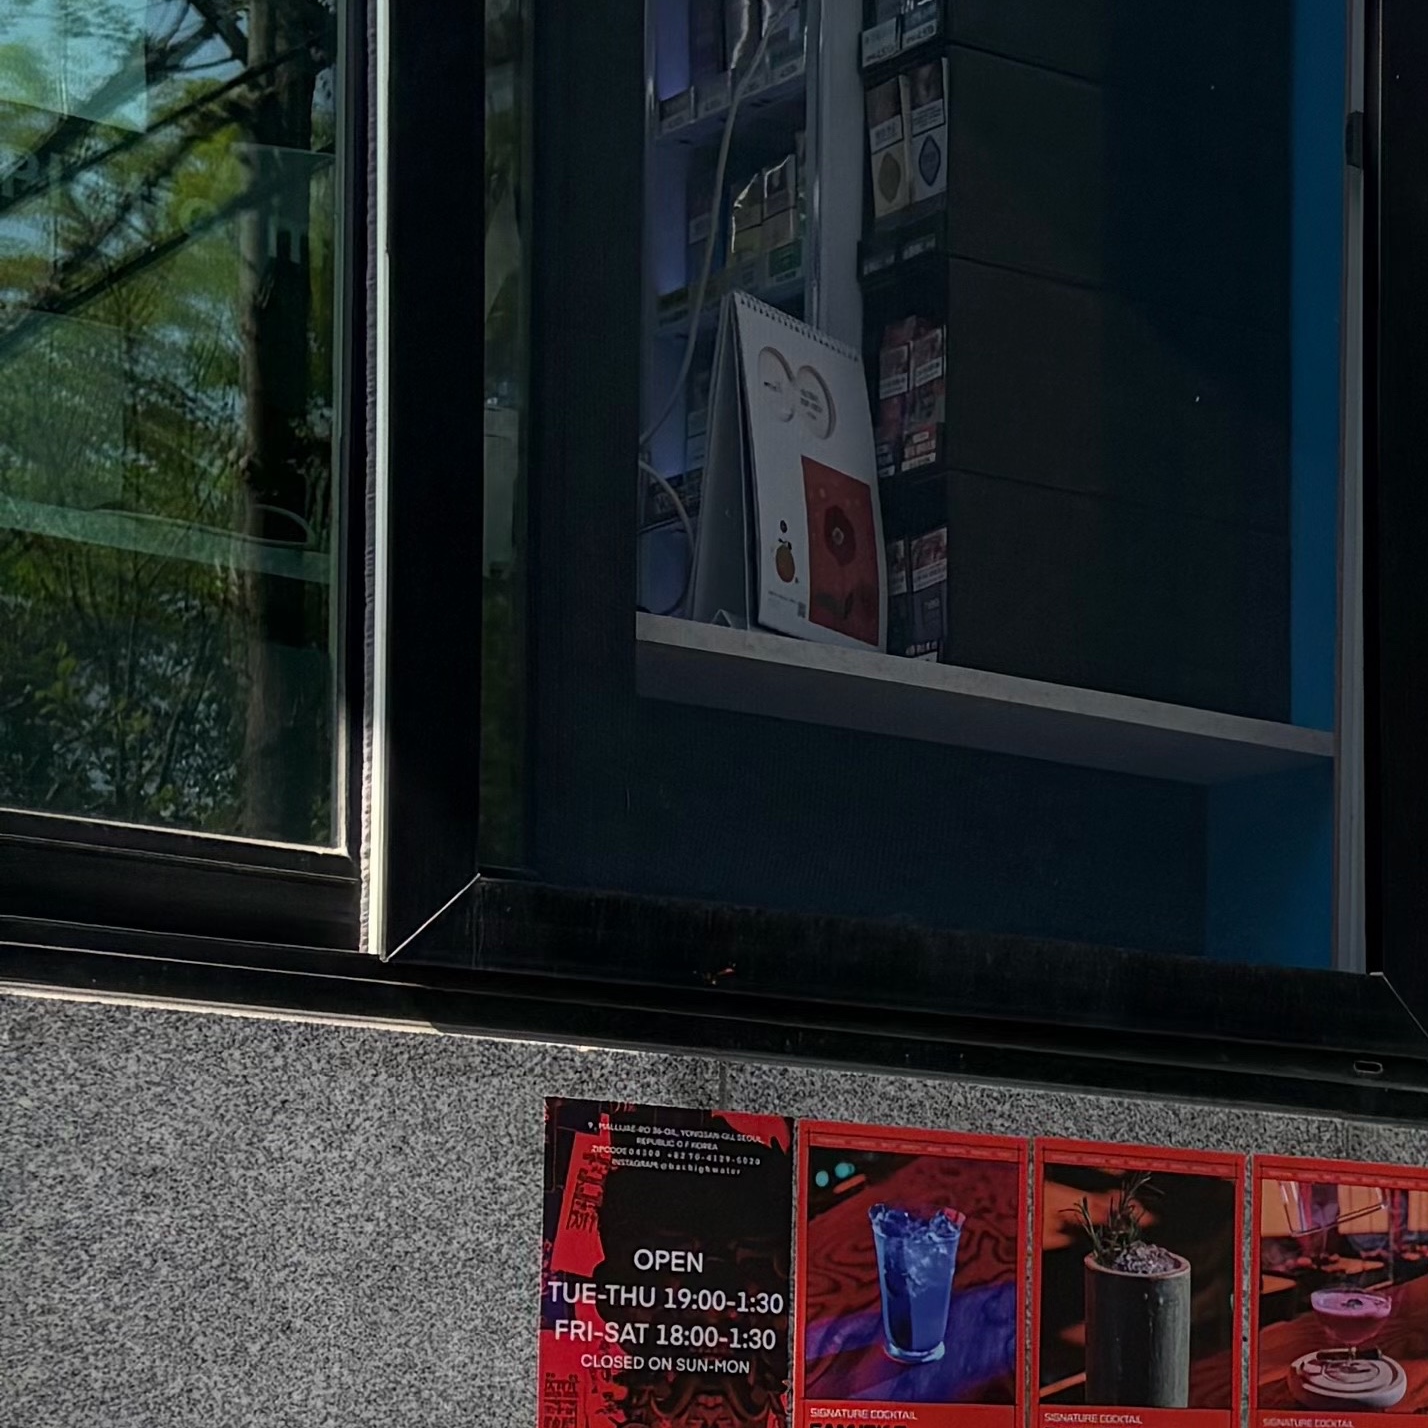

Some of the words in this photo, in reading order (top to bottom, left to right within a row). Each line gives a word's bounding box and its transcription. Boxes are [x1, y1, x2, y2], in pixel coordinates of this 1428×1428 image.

[636, 1137, 675, 1147] REPUBLIC
[691, 1141, 718, 1151] KOREA
[633, 1248, 704, 1273] OPEN
[548, 1280, 657, 1309] TUE-THU
[663, 1287, 784, 1315] 19:00-1:30
[554, 1320, 650, 1345] FRI-SAT
[655, 1324, 776, 1350] 18:00-1:30
[580, 1354, 644, 1371] CLOSED
[648, 1356, 671, 1371] ON
[676, 1357, 750, 1374] SUN-MON
[810, 1408, 870, 1420] SIGNATURE
[870, 1410, 917, 1420] COCKTAIL
[1044, 1413, 1098, 1423] SIGNATURE
[1099, 1414, 1143, 1424] COCKTAIL
[1262, 1418, 1313, 1428] SIGNATURE
[1314, 1419, 1354, 1428] COCKTAIL
